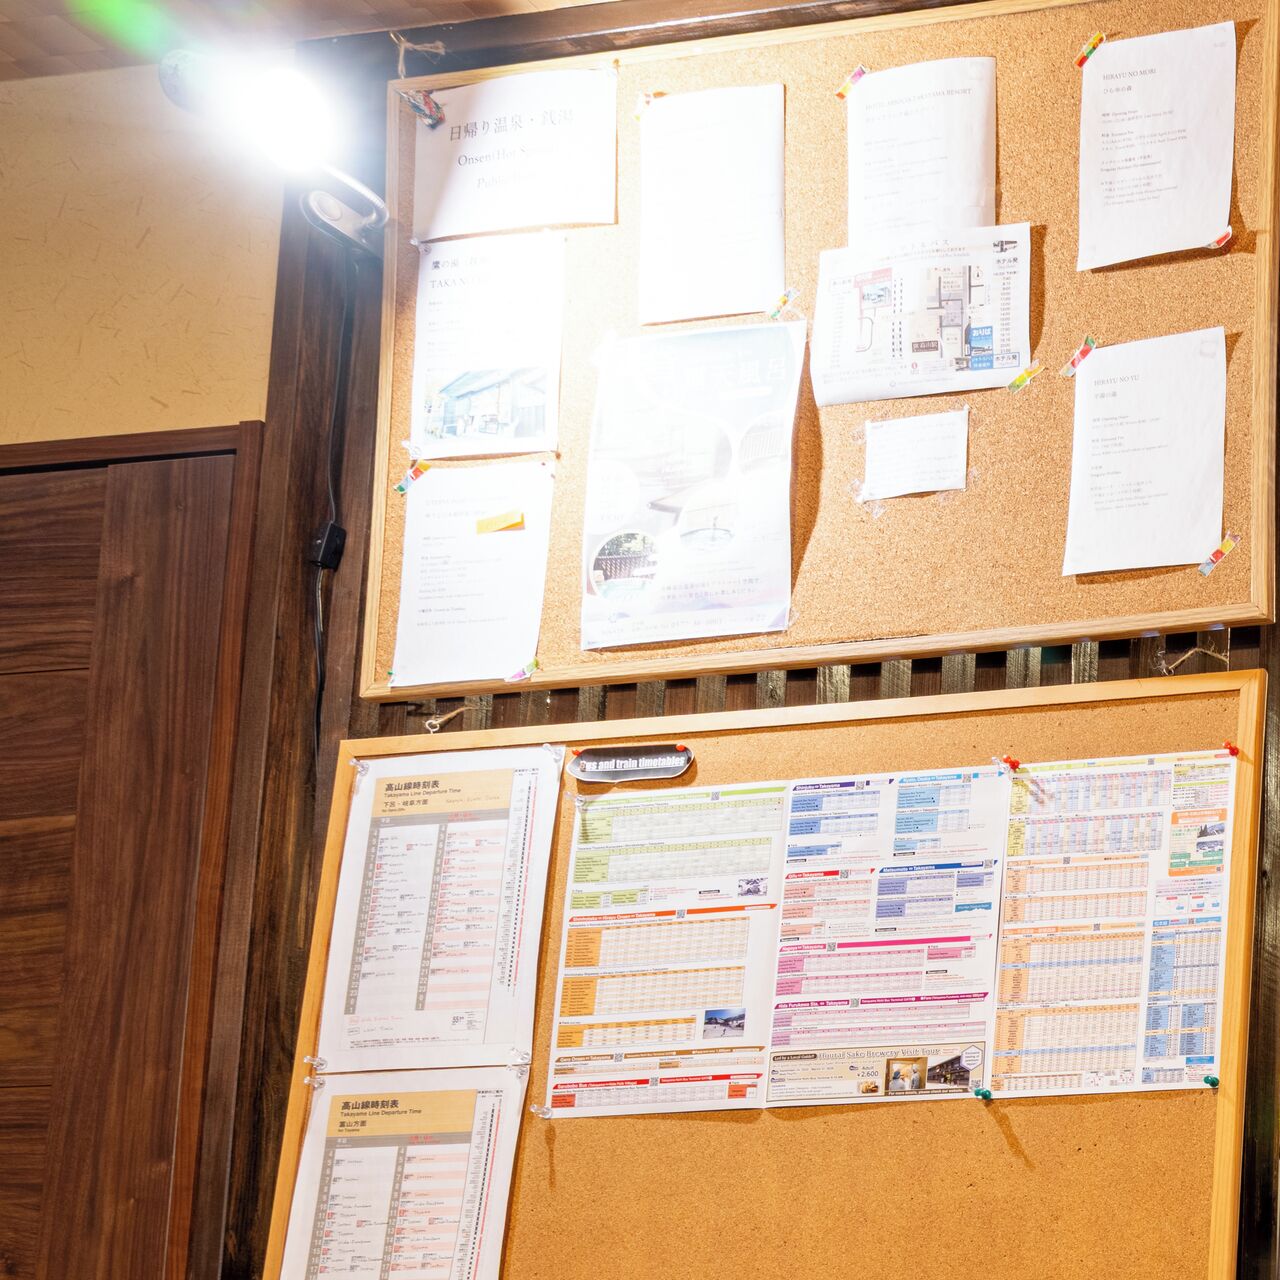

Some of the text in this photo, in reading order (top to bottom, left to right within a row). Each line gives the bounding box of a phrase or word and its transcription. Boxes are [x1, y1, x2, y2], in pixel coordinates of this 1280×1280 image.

[597, 759, 615, 770] and
[616, 757, 638, 769] train
[638, 755, 686, 769] timetables
[385, 780, 440, 792] 高山線時刻表
[384, 791, 409, 800] Takayama
[422, 789, 448, 797] Departure
[866, 1049, 899, 1059] Brewery
[901, 1048, 919, 1057] Visit
[341, 1099, 399, 1110] 高山線時刻表
[340, 1110, 367, 1118] Takayama
[381, 1108, 408, 1116] Departure
